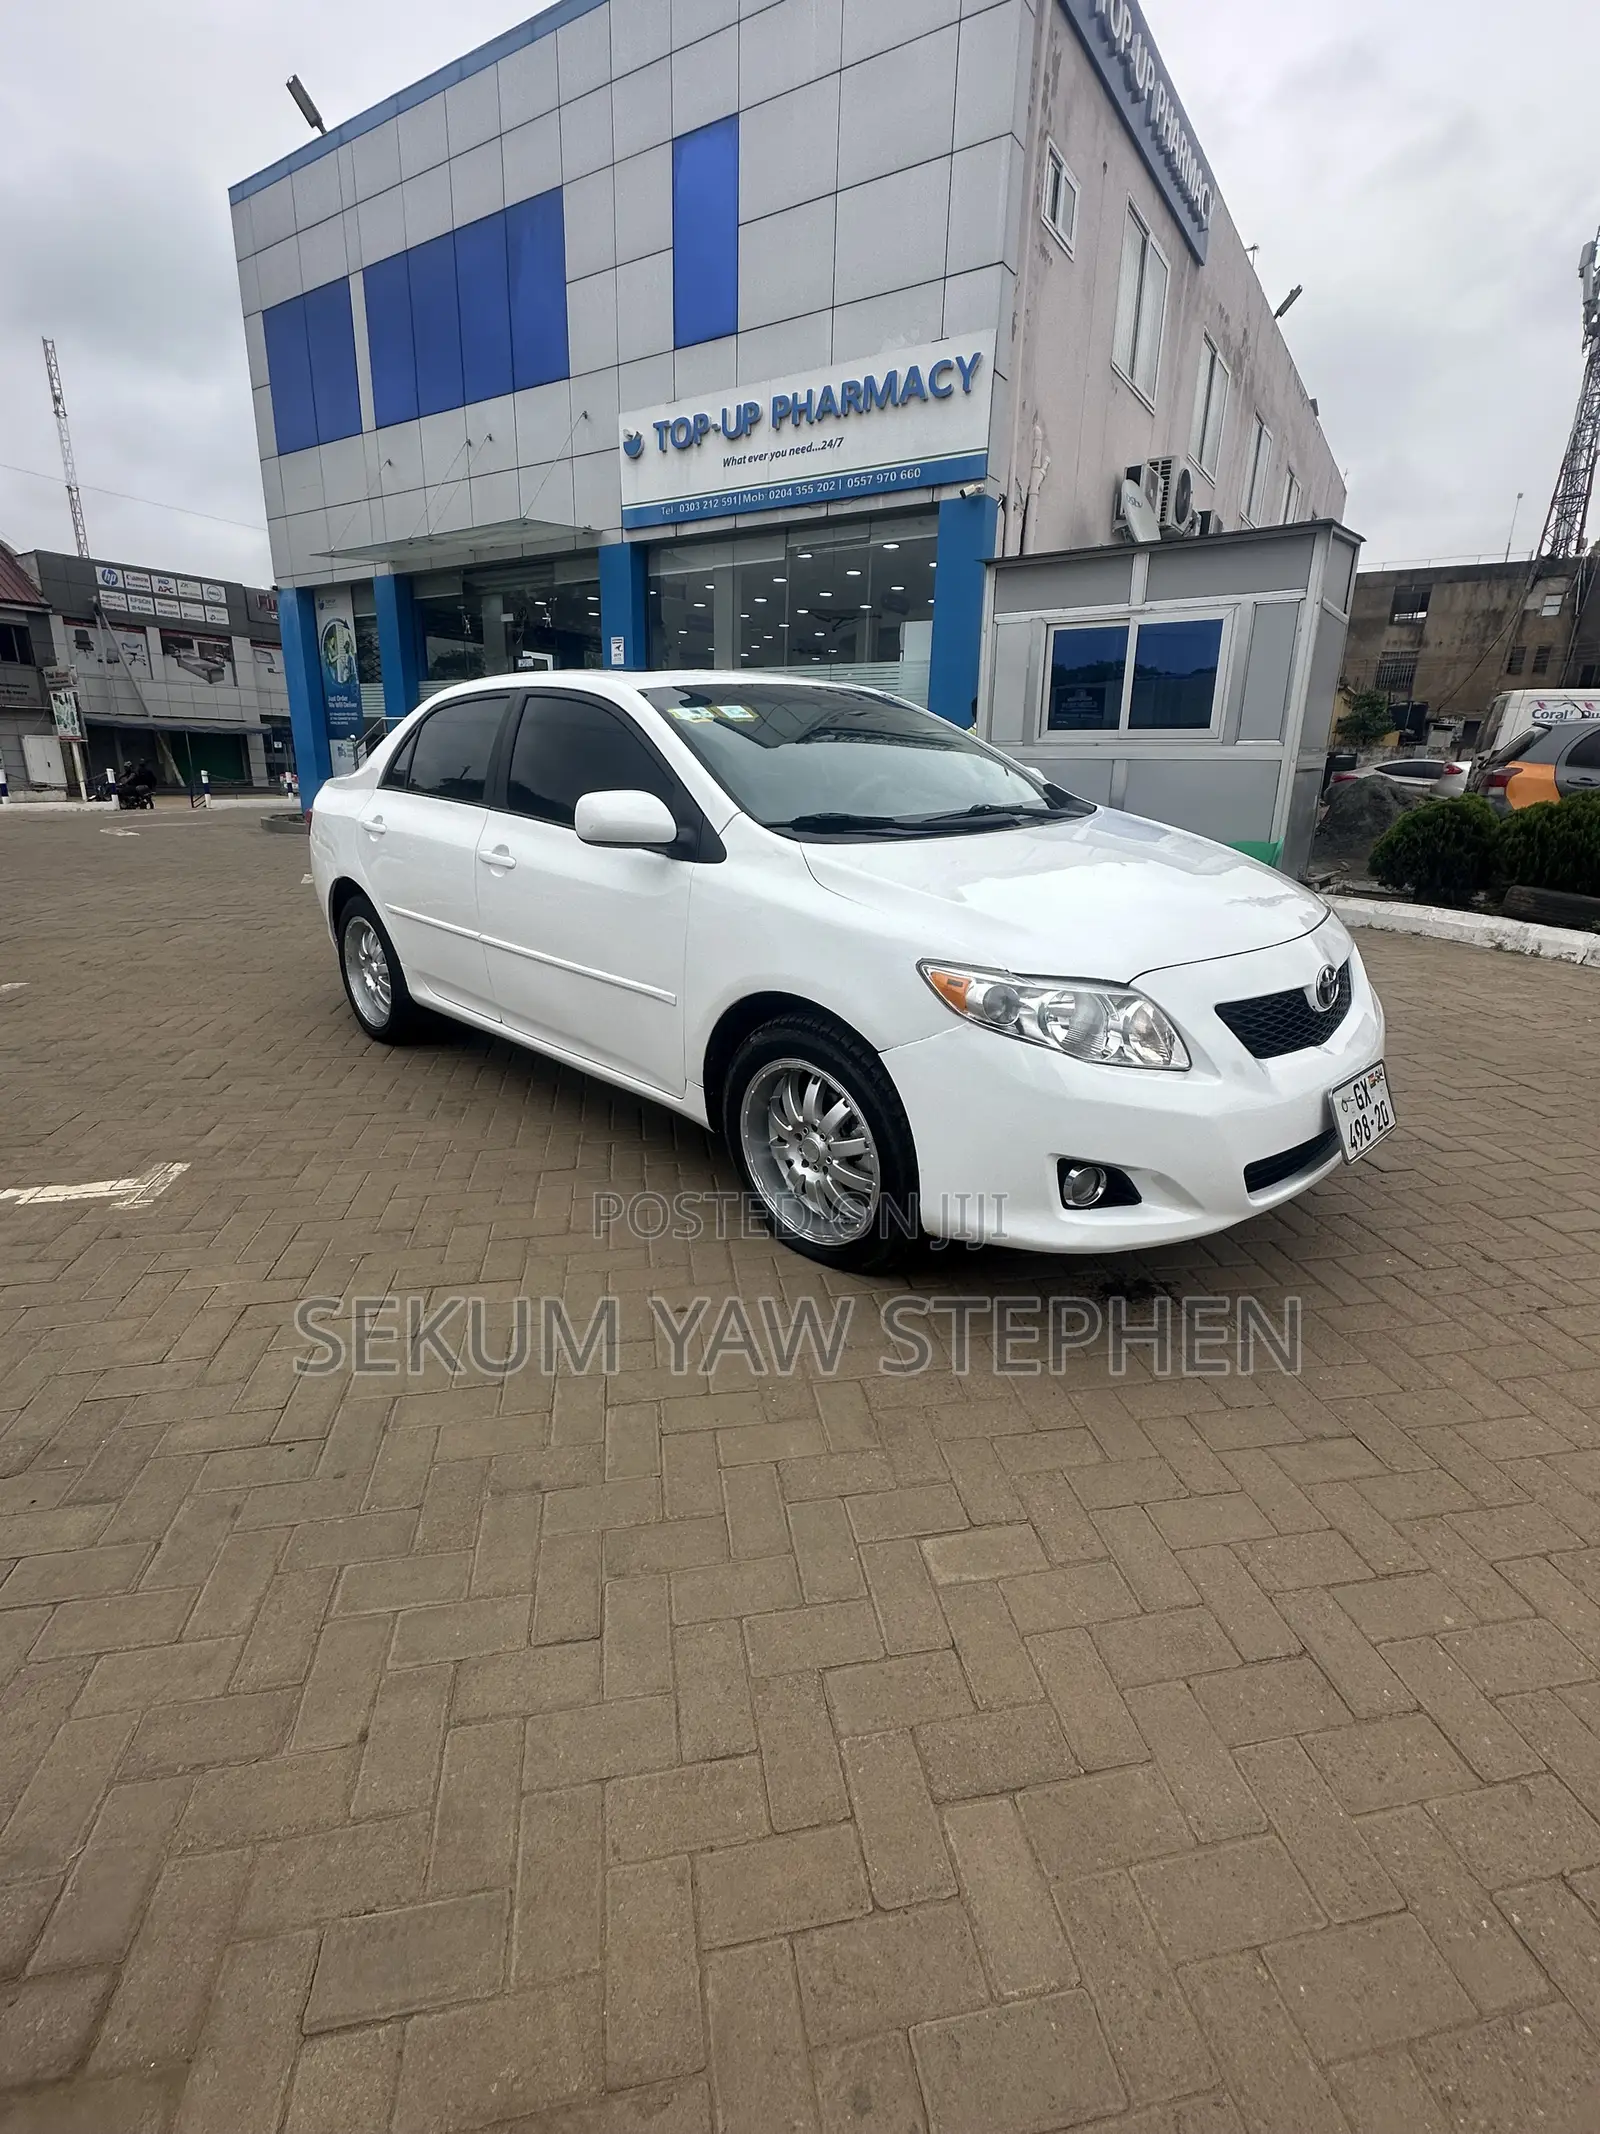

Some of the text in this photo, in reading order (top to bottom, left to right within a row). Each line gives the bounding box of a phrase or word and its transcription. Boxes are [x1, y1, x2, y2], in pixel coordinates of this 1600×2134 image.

[1150, 80, 1217, 220] PHARMACY
[653, 351, 984, 452] TOP-UP PHARMACY
[723, 456, 747, 468] What
[747, 452, 768, 463] ever
[768, 449, 787, 462] you
[679, 501, 700, 512] 0303
[703, 499, 719, 509] 212
[768, 487, 792, 500] 0204
[795, 484, 814, 496] 355
[817, 480, 836, 493] 202
[847, 475, 873, 488] 0557
[876, 471, 897, 483] 970
[900, 467, 921, 480] 660
[103, 568, 118, 585] hp
[158, 585, 174, 594] APC
[1532, 708, 1568, 720] Coral
[1353, 1078, 1372, 1111] GX
